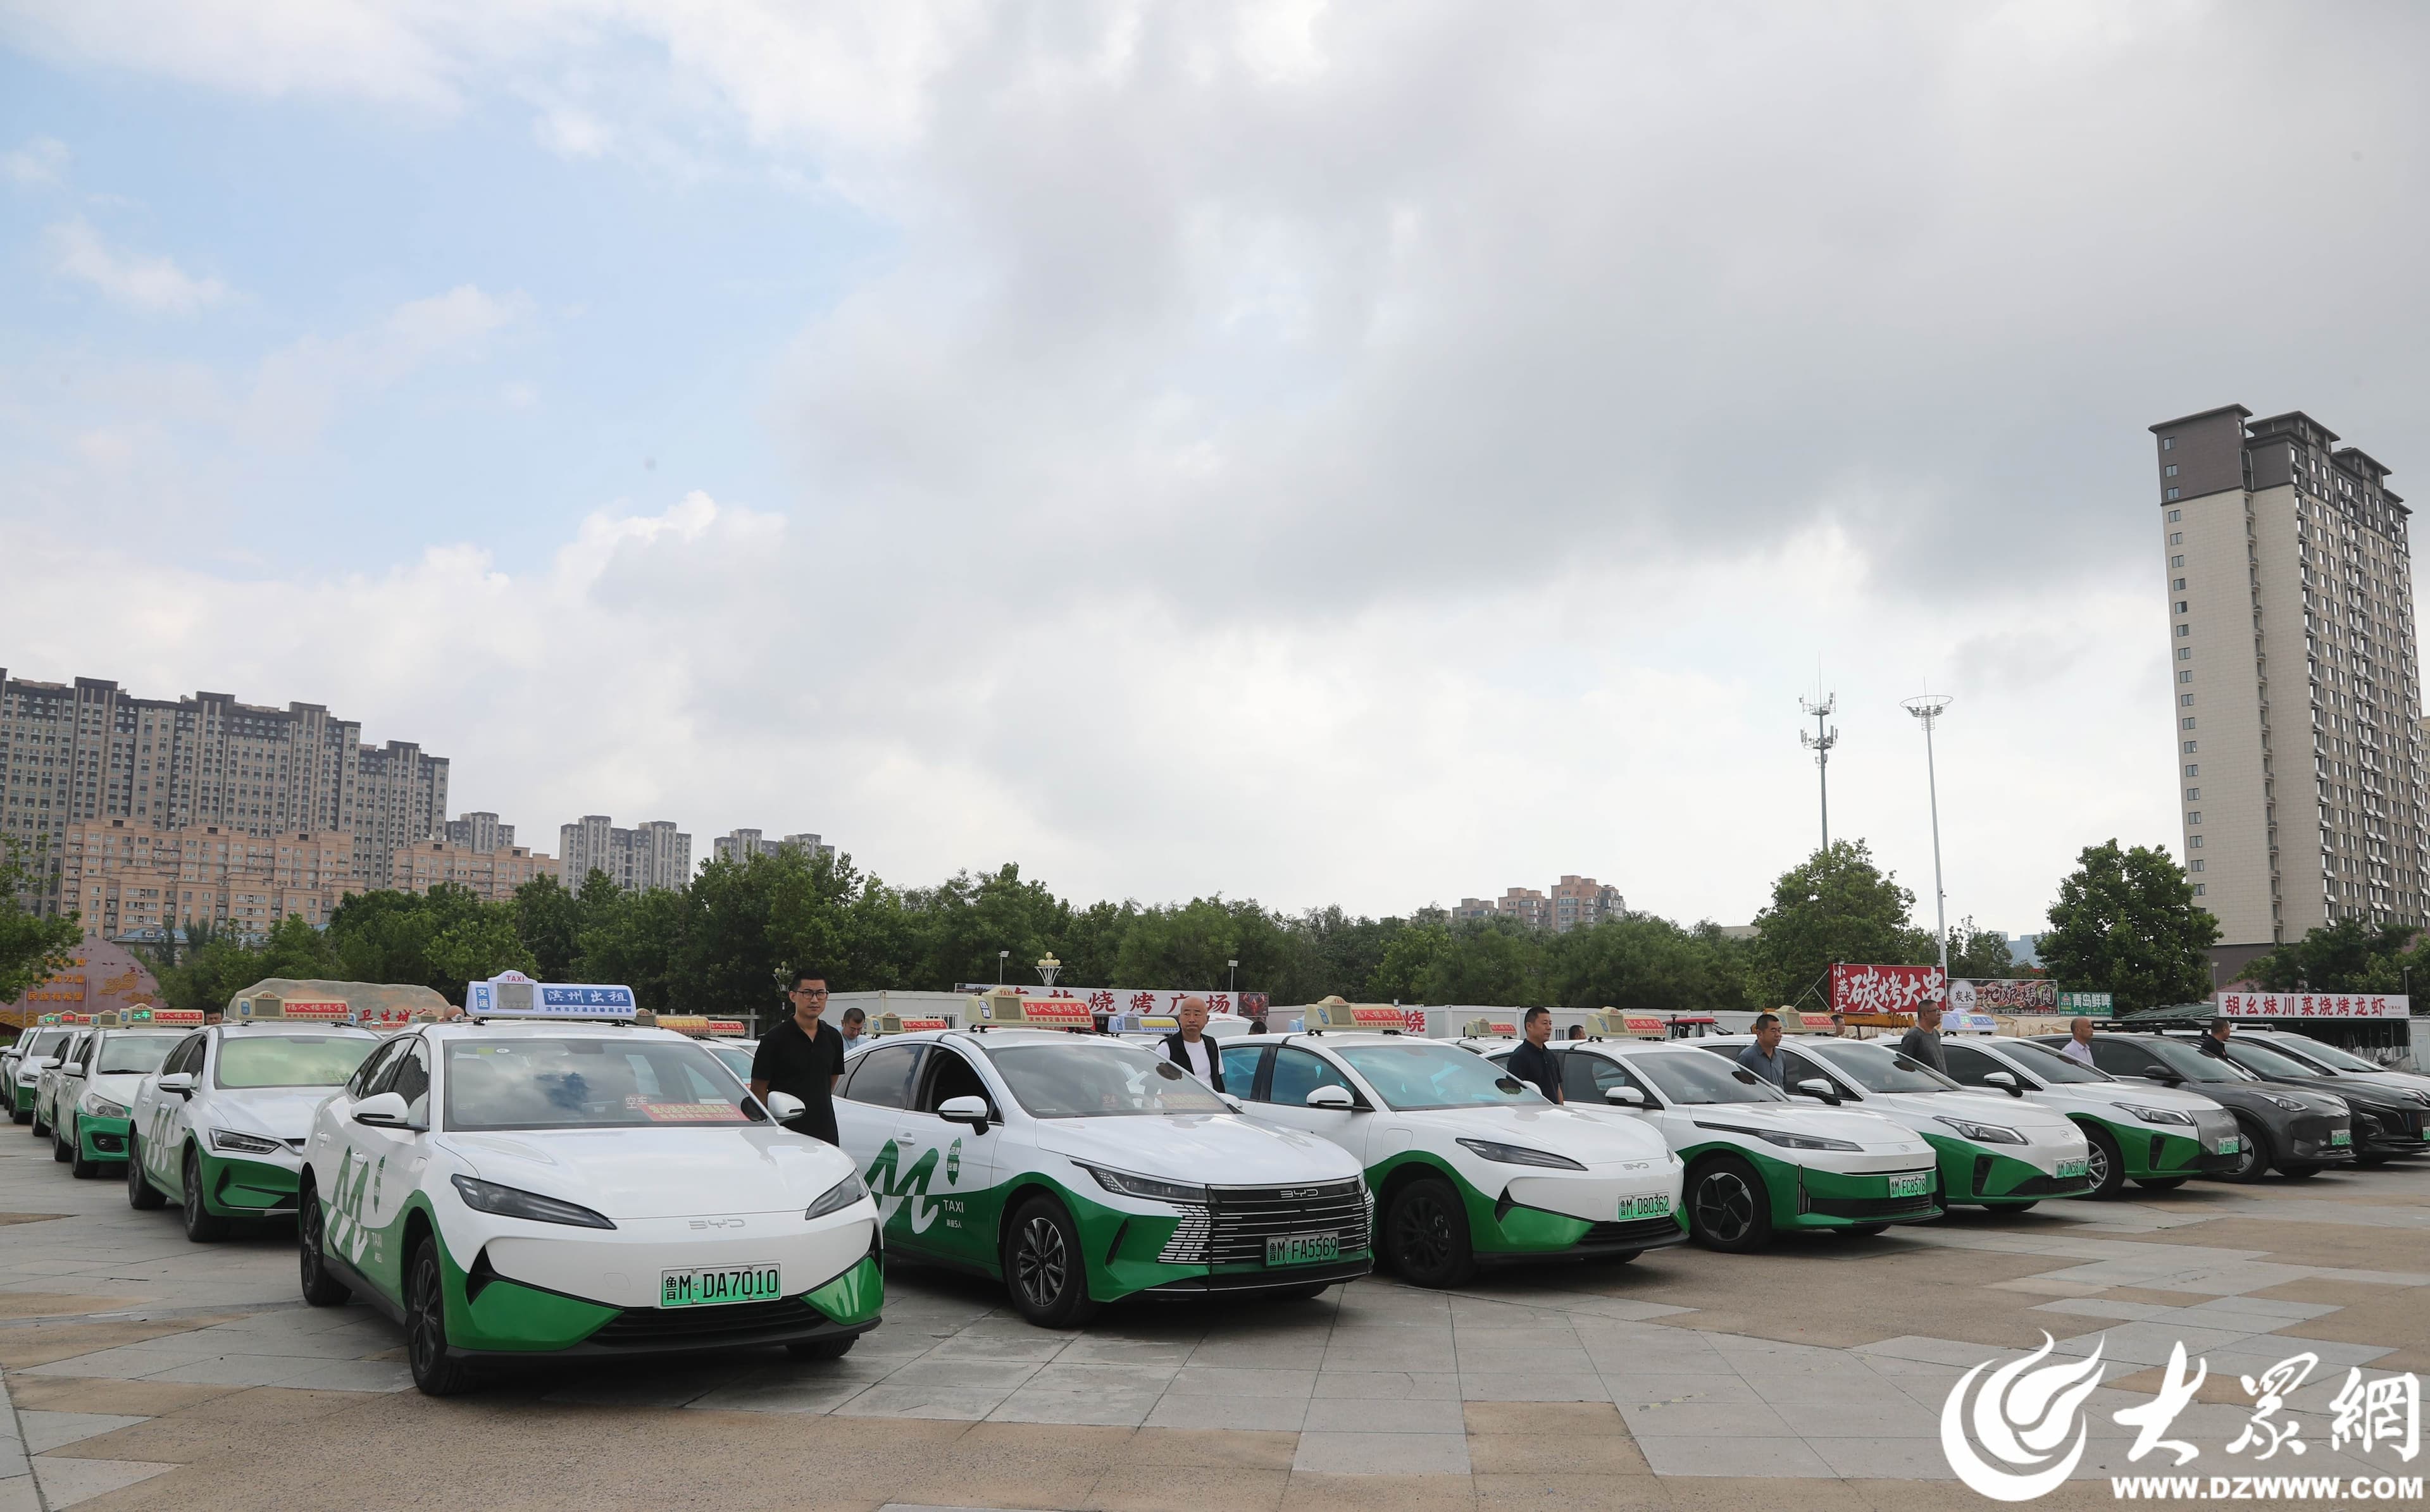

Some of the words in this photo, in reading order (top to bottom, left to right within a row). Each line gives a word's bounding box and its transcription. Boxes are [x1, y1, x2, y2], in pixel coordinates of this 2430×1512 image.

[1833, 965, 1849, 1012] 小燕子
[1847, 965, 1945, 1012] 碳烤大串
[28, 991, 84, 1001] 民族有希望
[477, 988, 489, 1008] 交运
[547, 989, 628, 1003] 滨州出租
[1014, 987, 1231, 1015] 烧烤广场
[1955, 991, 1974, 1003] 炭长
[1983, 985, 2055, 1007] 地炉烤肉
[2072, 993, 2111, 1008] 青岛鲜啤
[286, 1003, 345, 1012] 福人楼珠宝
[1026, 1003, 1087, 1013] 福人楼珠宝
[1354, 1010, 1401, 1019] 福人楼珠宝
[1403, 1010, 1425, 1032] 烧
[625, 1096, 648, 1109] 空车
[1623, 1162, 1650, 1170] BYD
[1280, 1188, 1319, 1199] BYD
[943, 1199, 964, 1214] TAXI
[688, 1218, 746, 1230] BYD
